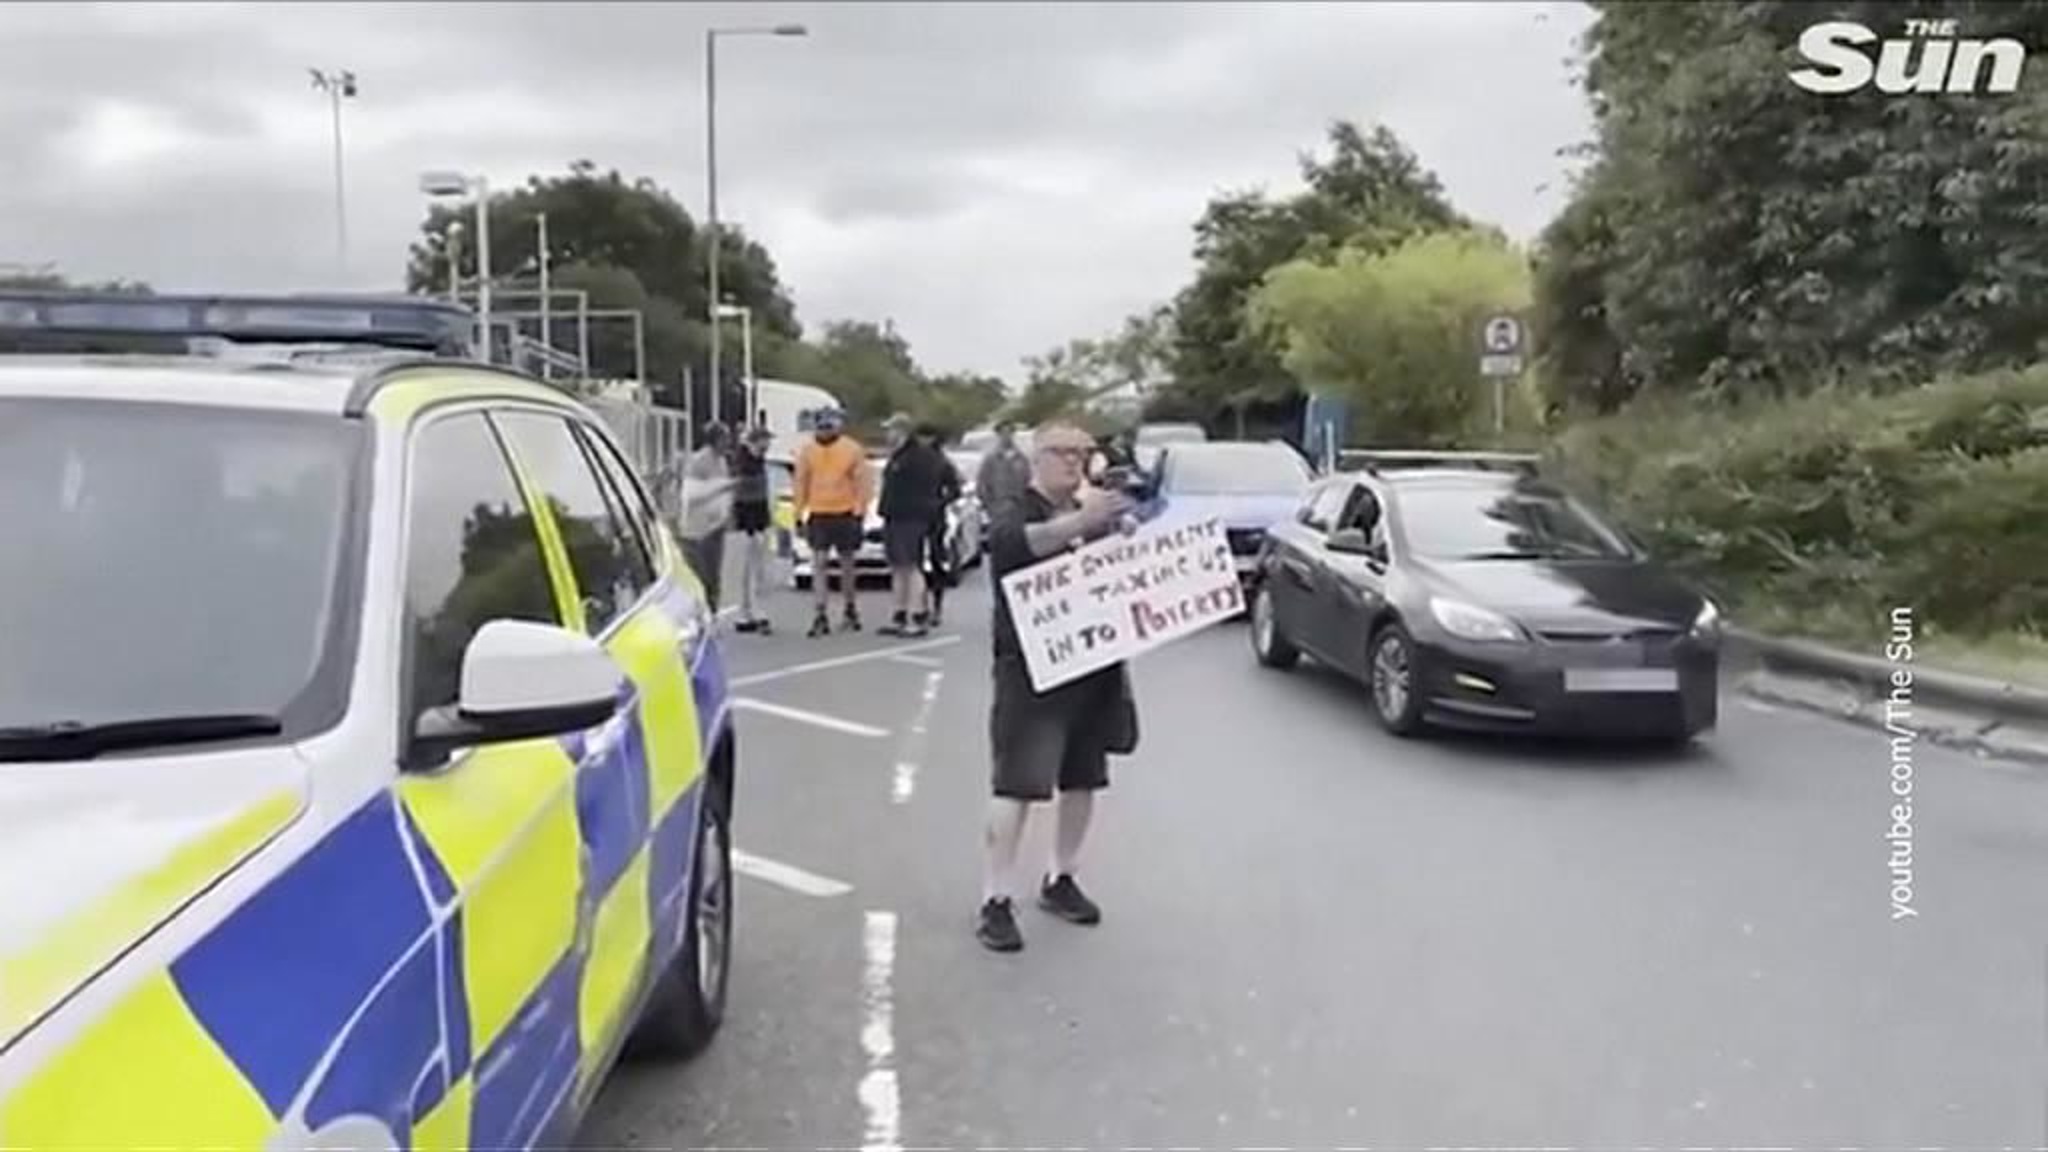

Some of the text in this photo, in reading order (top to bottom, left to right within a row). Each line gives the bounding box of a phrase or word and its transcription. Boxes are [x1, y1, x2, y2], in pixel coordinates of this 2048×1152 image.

[1014, 564, 1072, 603] THE
[1033, 599, 1071, 628] ARE
[1200, 544, 1228, 573] US
